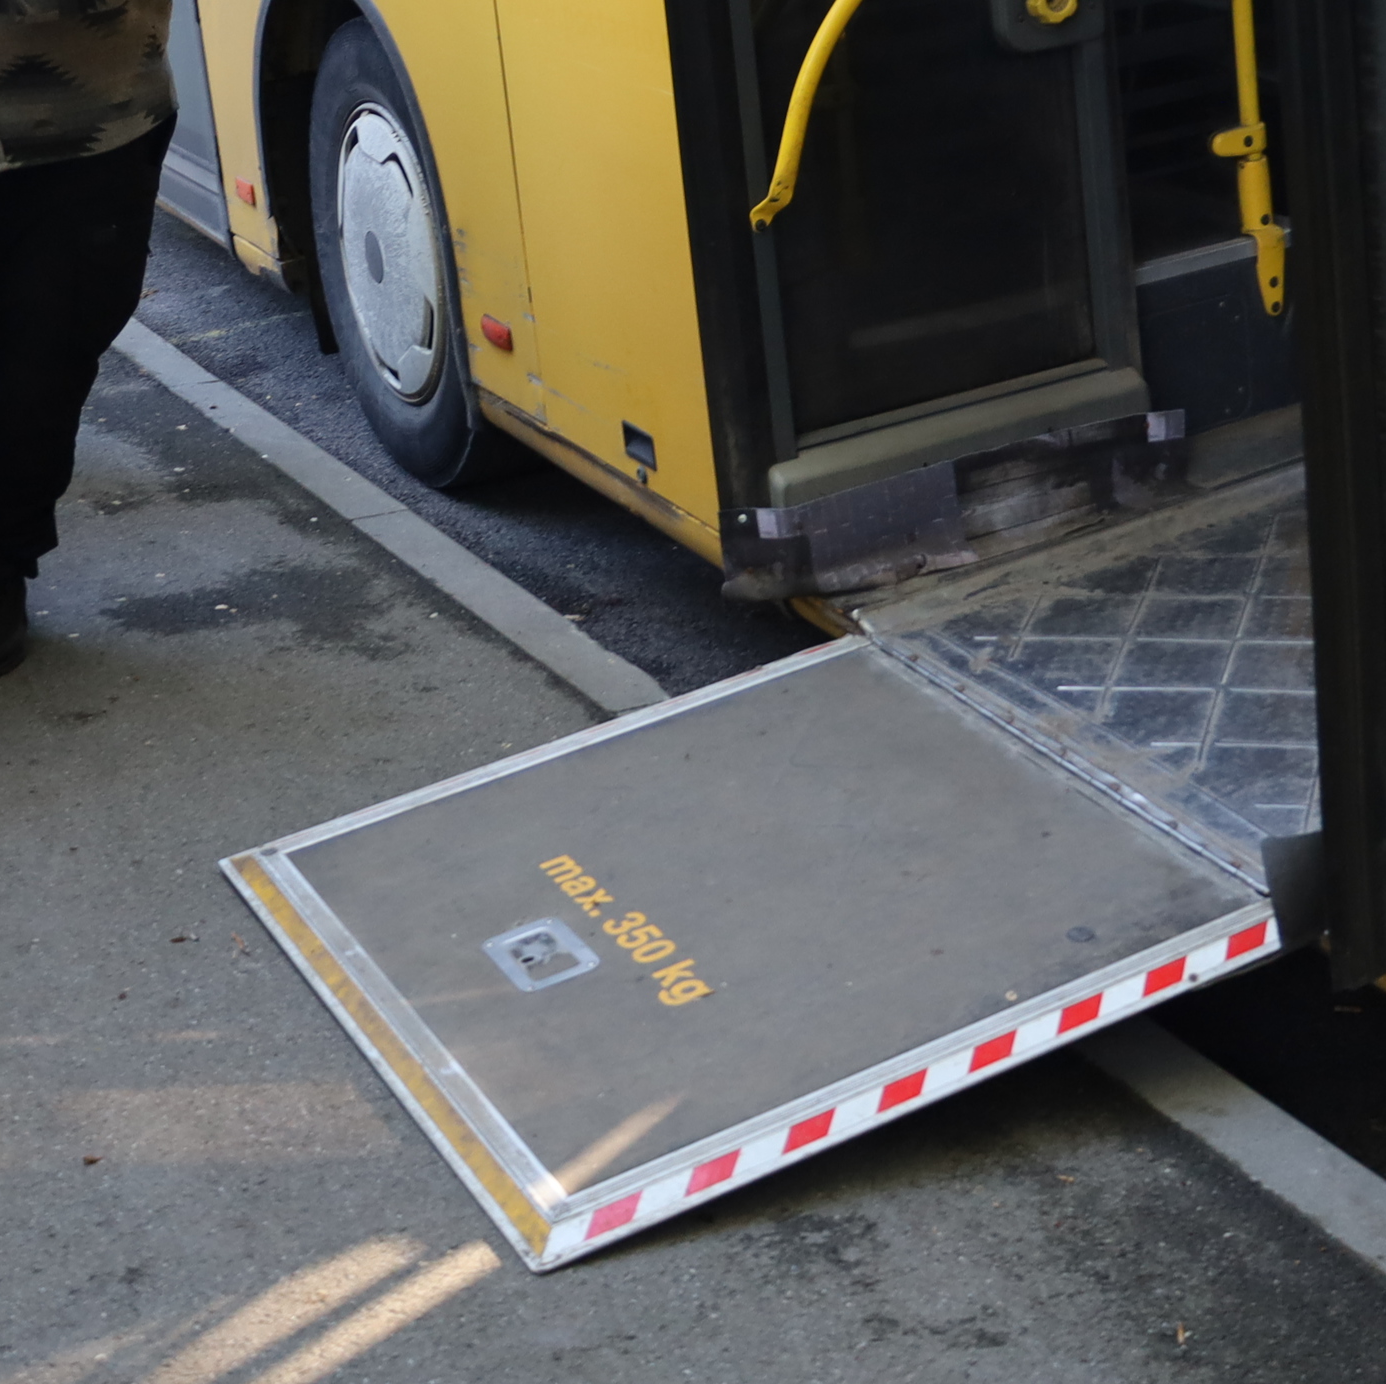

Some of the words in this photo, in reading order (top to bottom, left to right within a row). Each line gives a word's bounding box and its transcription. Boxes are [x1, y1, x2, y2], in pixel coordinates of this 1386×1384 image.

[539, 854, 614, 918] max.
[602, 911, 677, 964] 350
[651, 958, 712, 1006] kg
